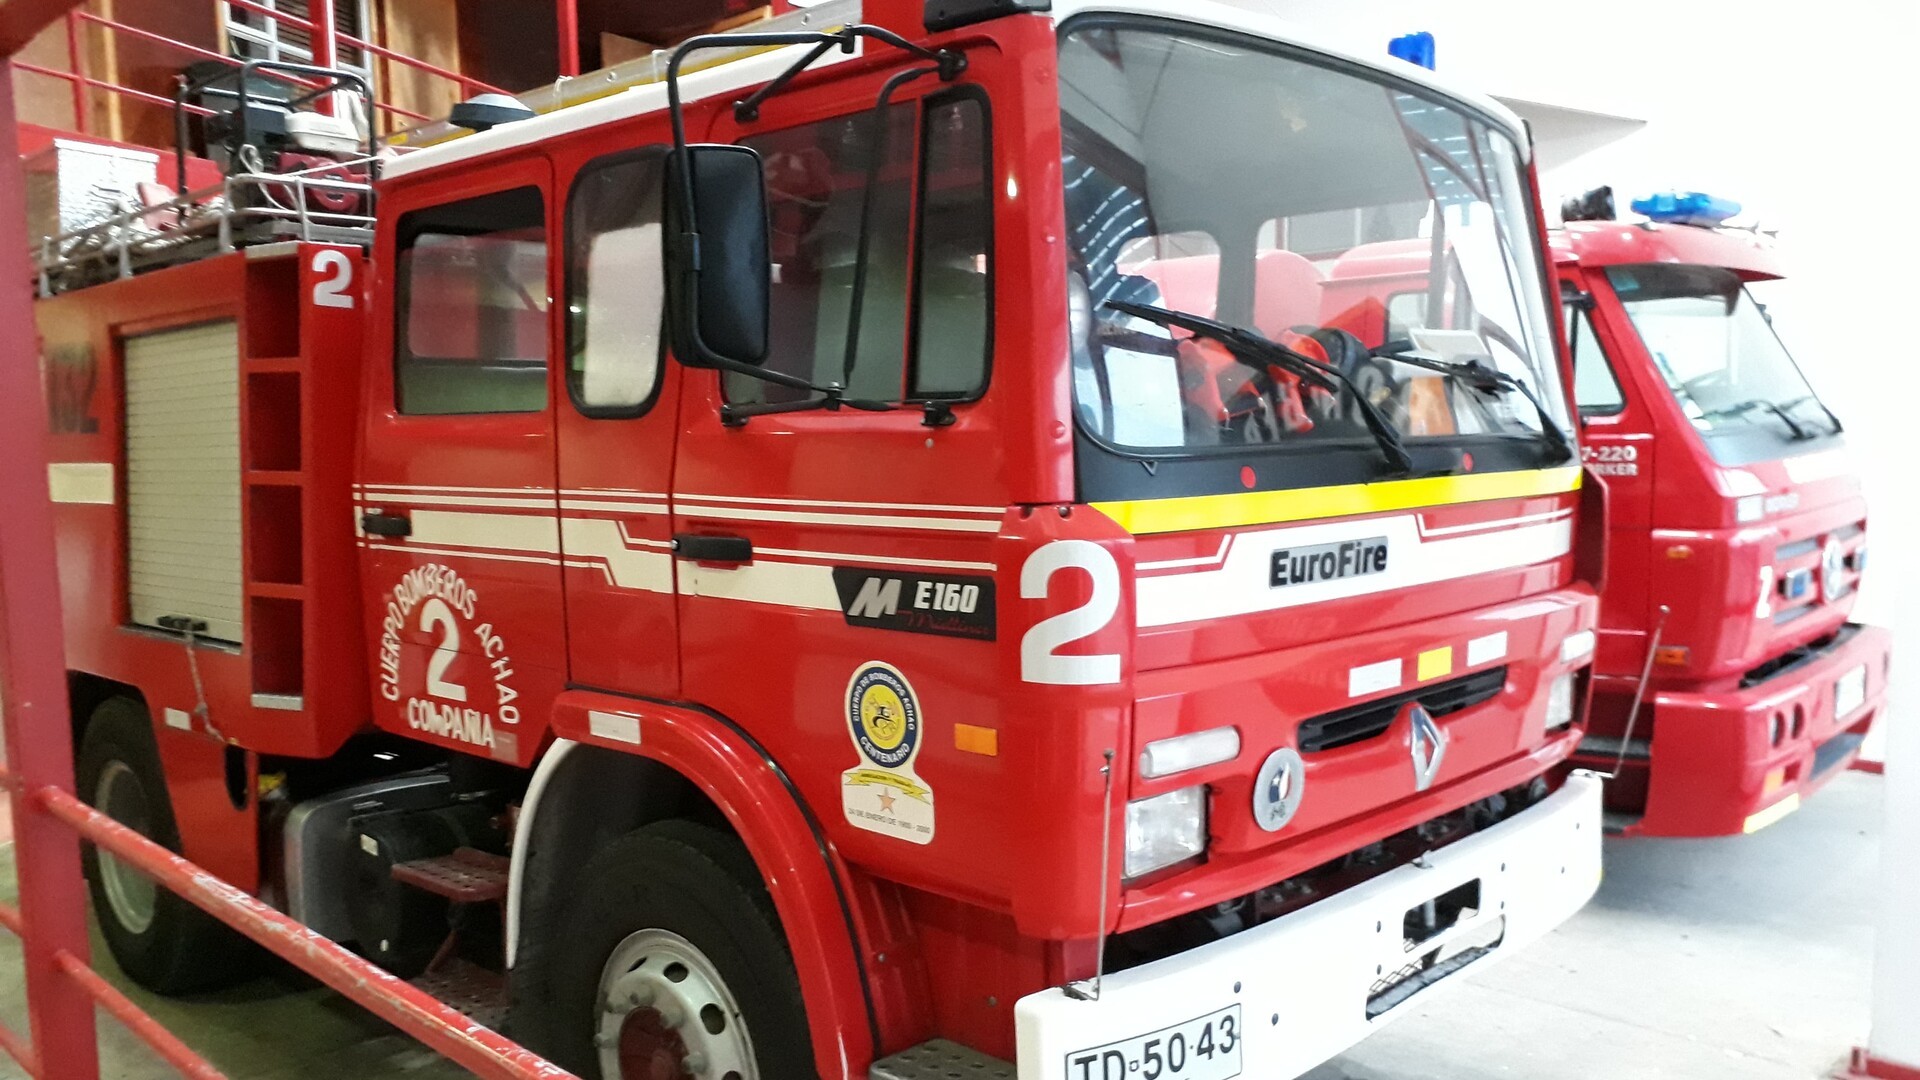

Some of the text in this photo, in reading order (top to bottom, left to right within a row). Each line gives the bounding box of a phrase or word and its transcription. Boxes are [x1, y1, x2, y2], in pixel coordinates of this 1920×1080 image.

[312, 249, 354, 309] 2
[1581, 445, 1638, 462] 7-220
[1271, 541, 1388, 588] EuroFire
[914, 580, 980, 614] E160
[1020, 540, 1121, 685] 2
[381, 563, 520, 724] CUERPO BOMBEROS ACHAO
[420, 598, 467, 702] 2
[860, 736, 910, 763] CENTENARIO
